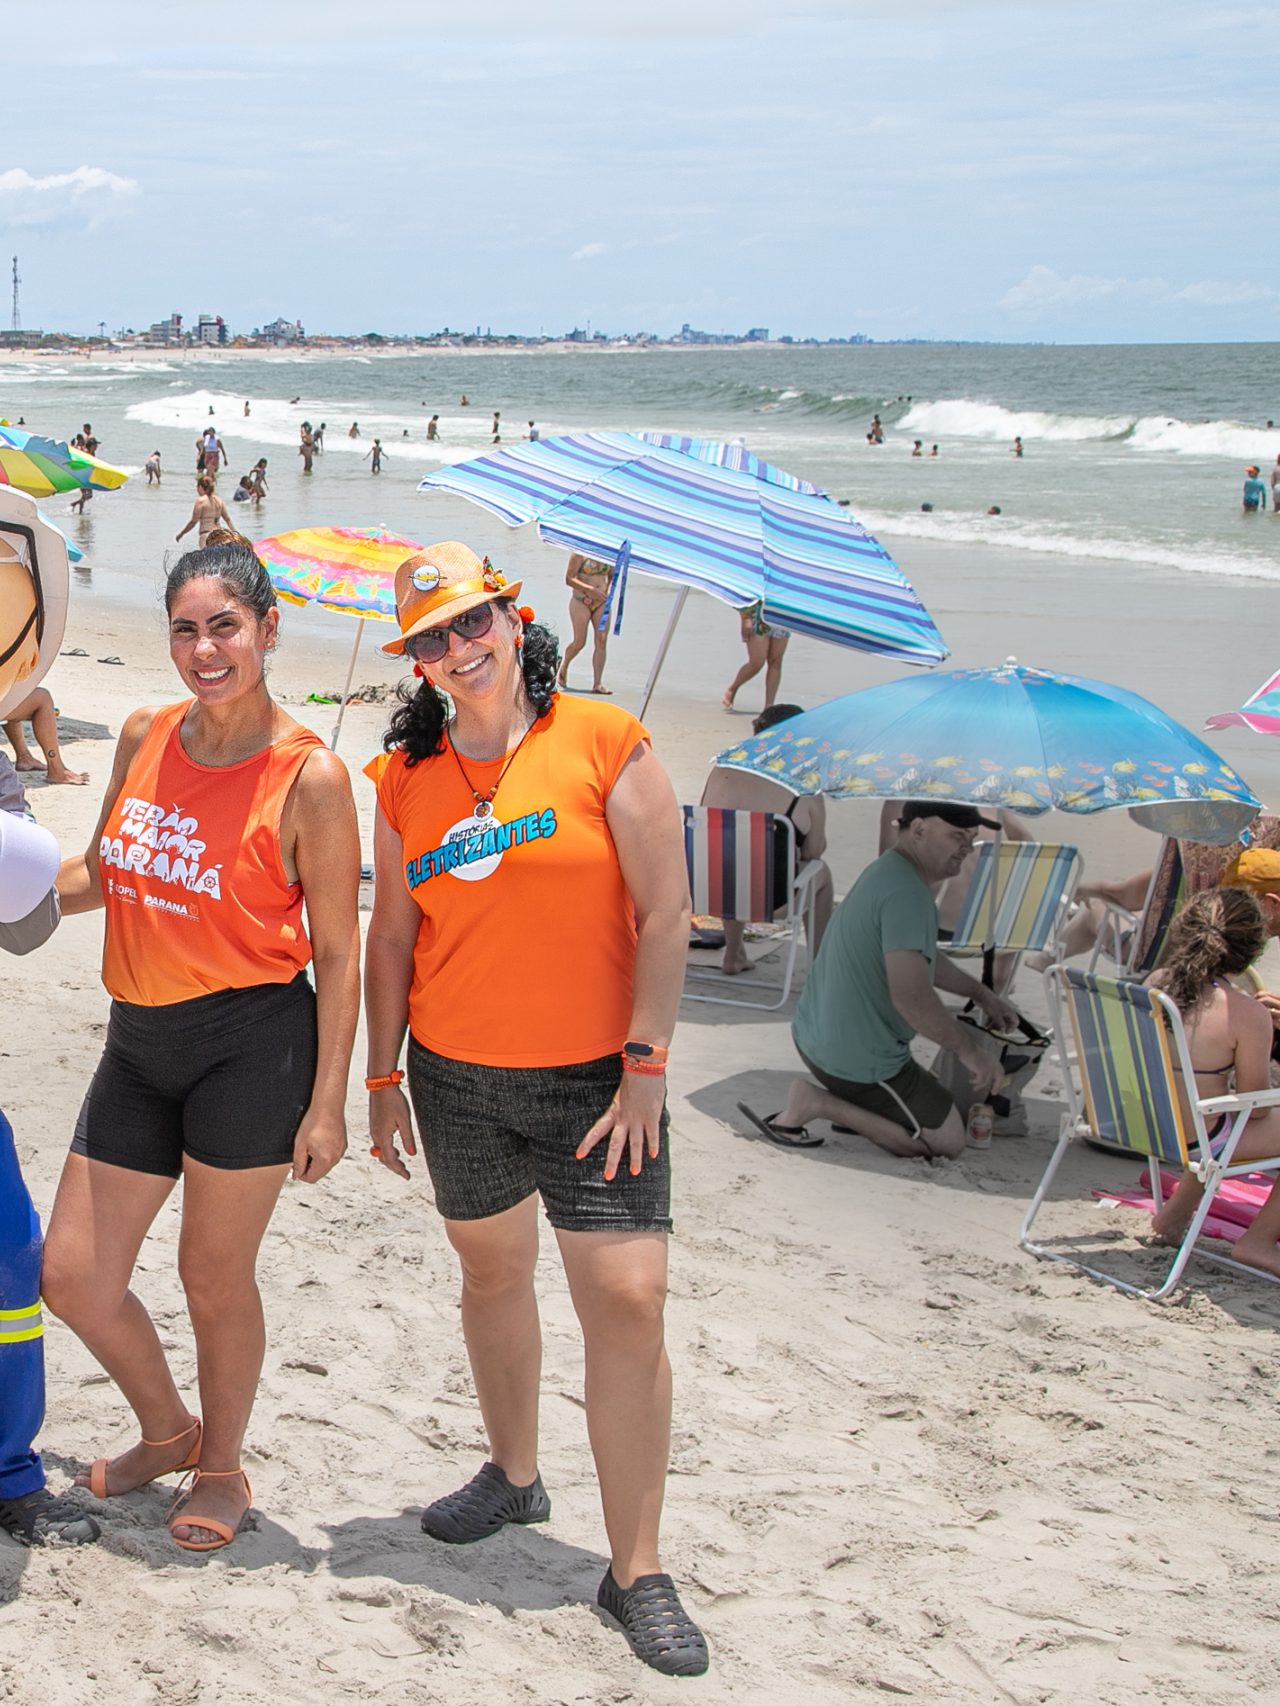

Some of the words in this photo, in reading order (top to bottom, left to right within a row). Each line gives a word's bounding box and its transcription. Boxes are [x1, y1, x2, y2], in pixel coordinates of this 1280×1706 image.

[99, 836, 223, 900] PARANÁ
[118, 818, 206, 861] MAIOR
[405, 807, 558, 891] ELETRIZANTES
